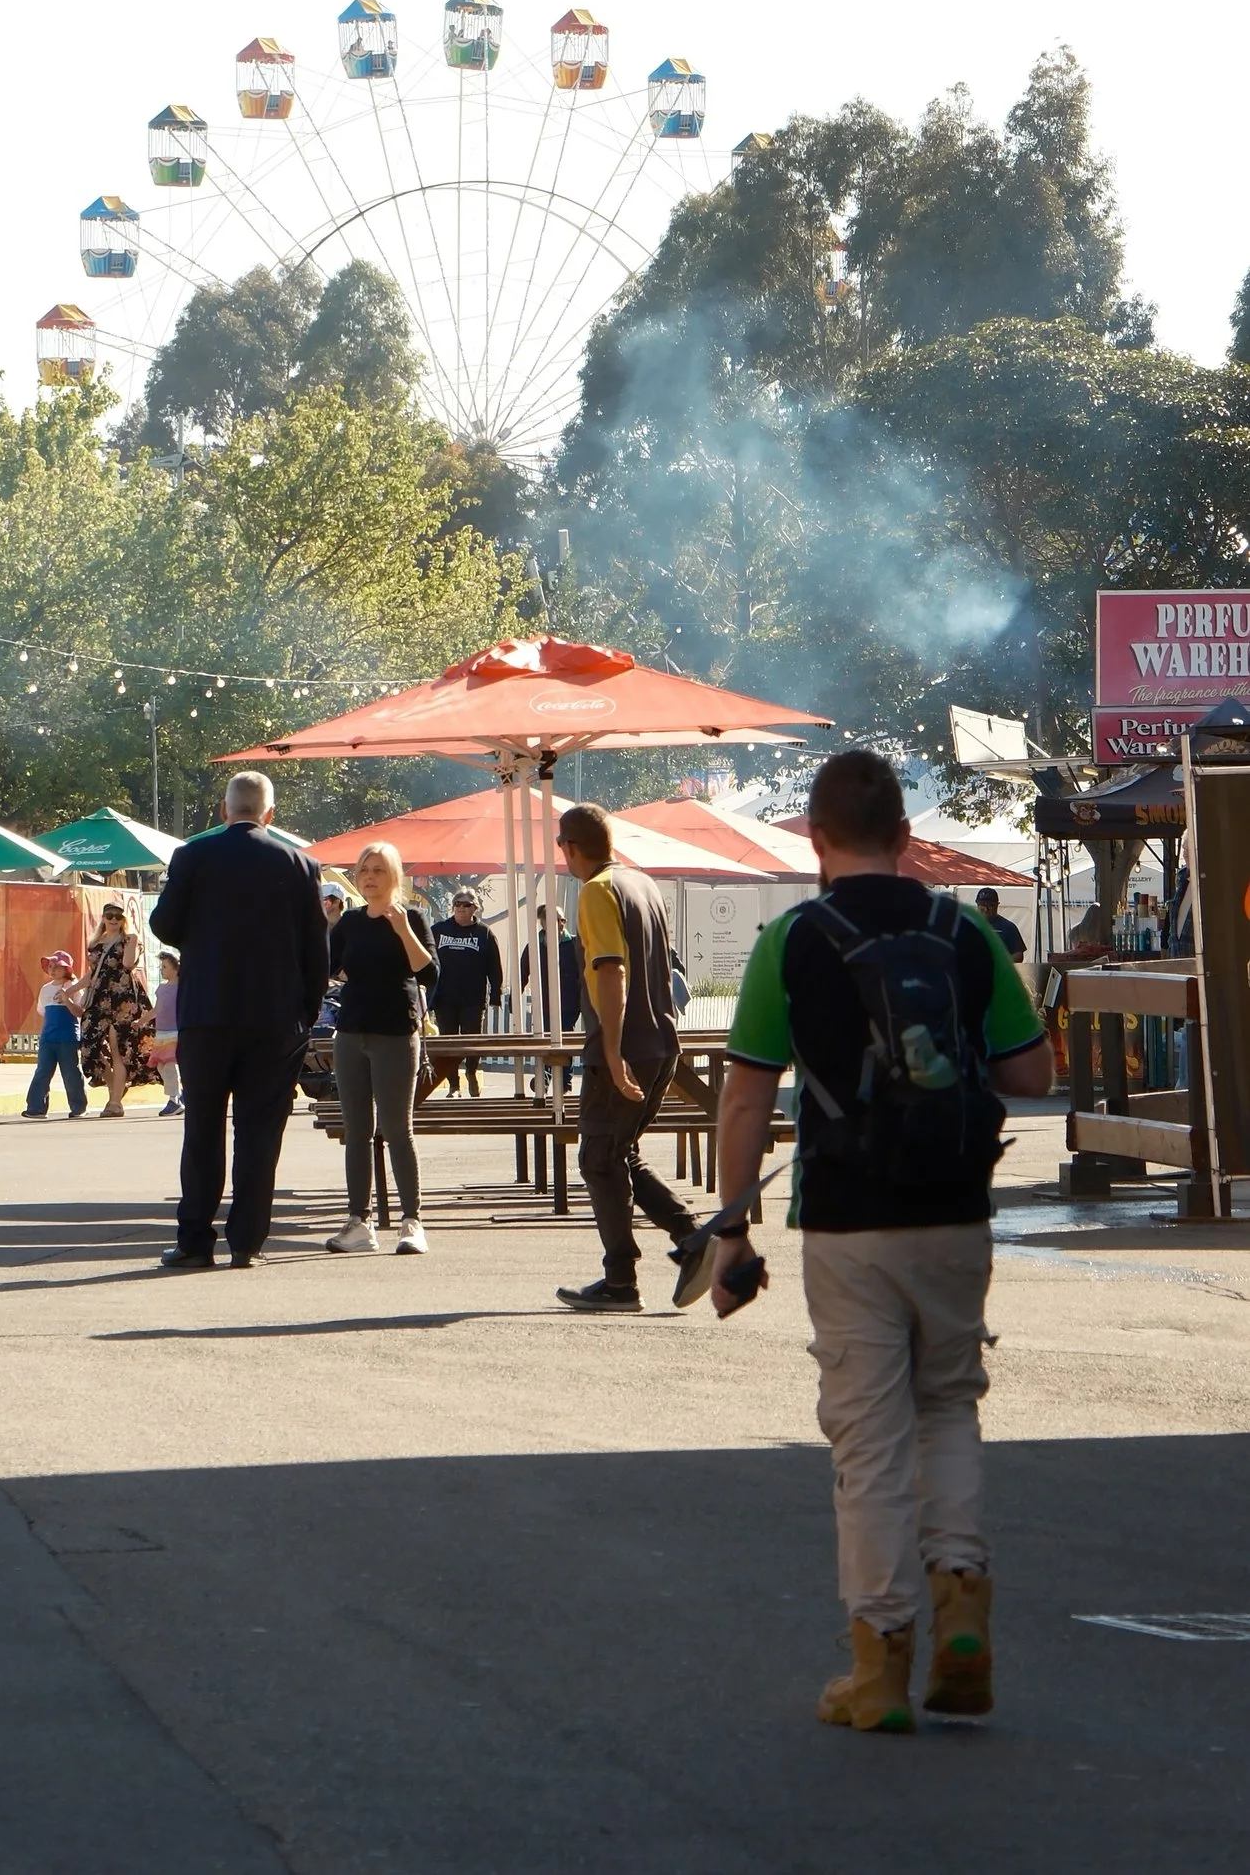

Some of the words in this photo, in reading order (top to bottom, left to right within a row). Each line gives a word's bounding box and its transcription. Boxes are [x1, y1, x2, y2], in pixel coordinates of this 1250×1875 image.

[1157, 603, 1250, 638] PERFU
[1130, 642, 1250, 677] WAREH
[536, 699, 607, 711] Coca-Cola
[1129, 684, 1153, 704] The
[1153, 684, 1217, 705] fragrance
[58, 838, 111, 855] Coopers
